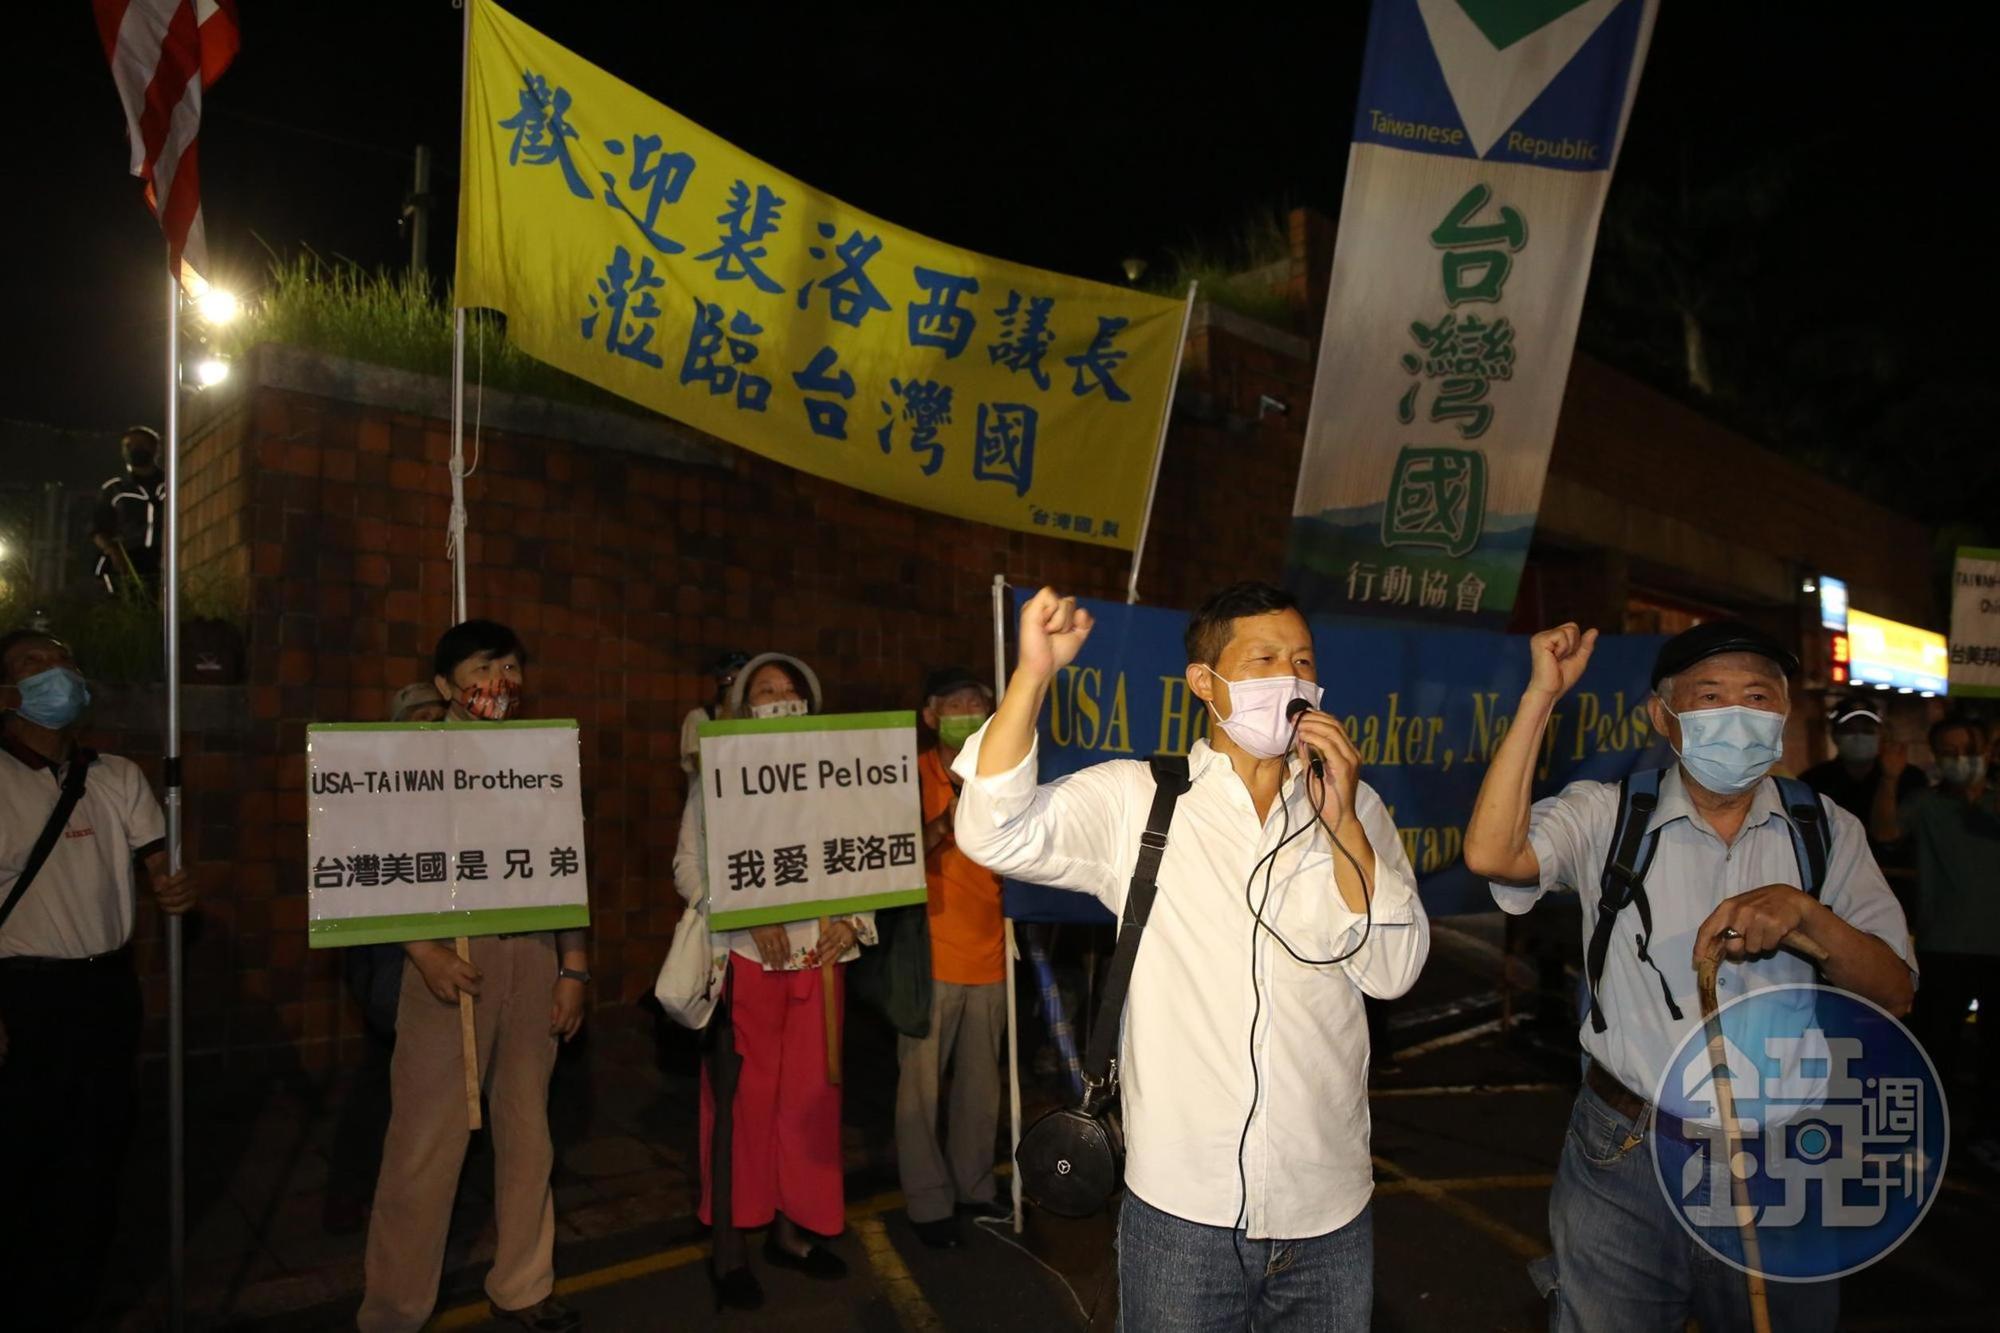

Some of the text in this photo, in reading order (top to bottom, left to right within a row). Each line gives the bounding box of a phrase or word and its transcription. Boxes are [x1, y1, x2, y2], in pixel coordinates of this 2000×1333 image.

[1369, 109, 1598, 161] Taiwanese Republic
[1380, 182, 1529, 558] 台灣國
[1346, 561, 1486, 614] 行動協會
[1050, 664, 1134, 753] USA
[1344, 692, 1453, 771] eaker,
[1464, 692, 1563, 781] Nay
[454, 769, 563, 790] Brothers
[715, 755, 909, 798] I LOVE Pelosi
